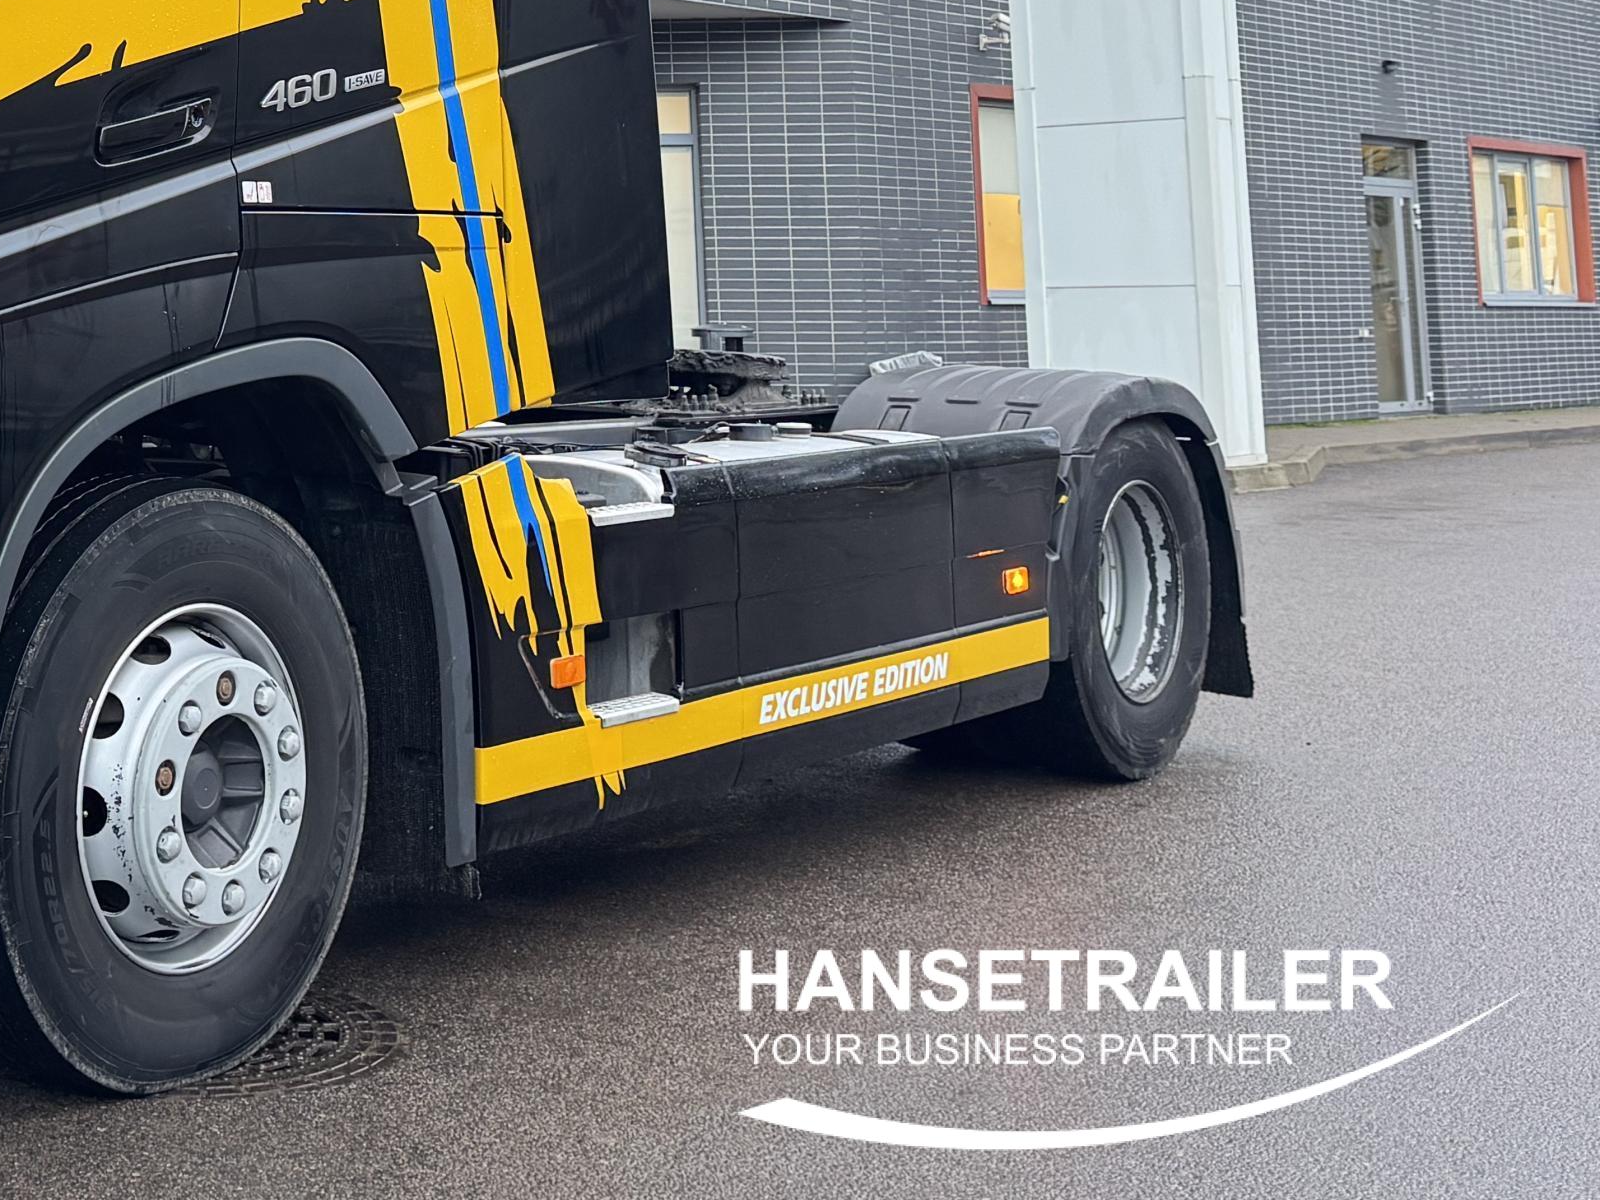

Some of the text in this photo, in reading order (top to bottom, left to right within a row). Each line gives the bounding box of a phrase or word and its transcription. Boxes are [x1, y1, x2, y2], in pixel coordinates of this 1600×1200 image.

[260, 68, 385, 112] 460 I-SAVE
[758, 651, 949, 725] EXCLUSIVE EDITION
